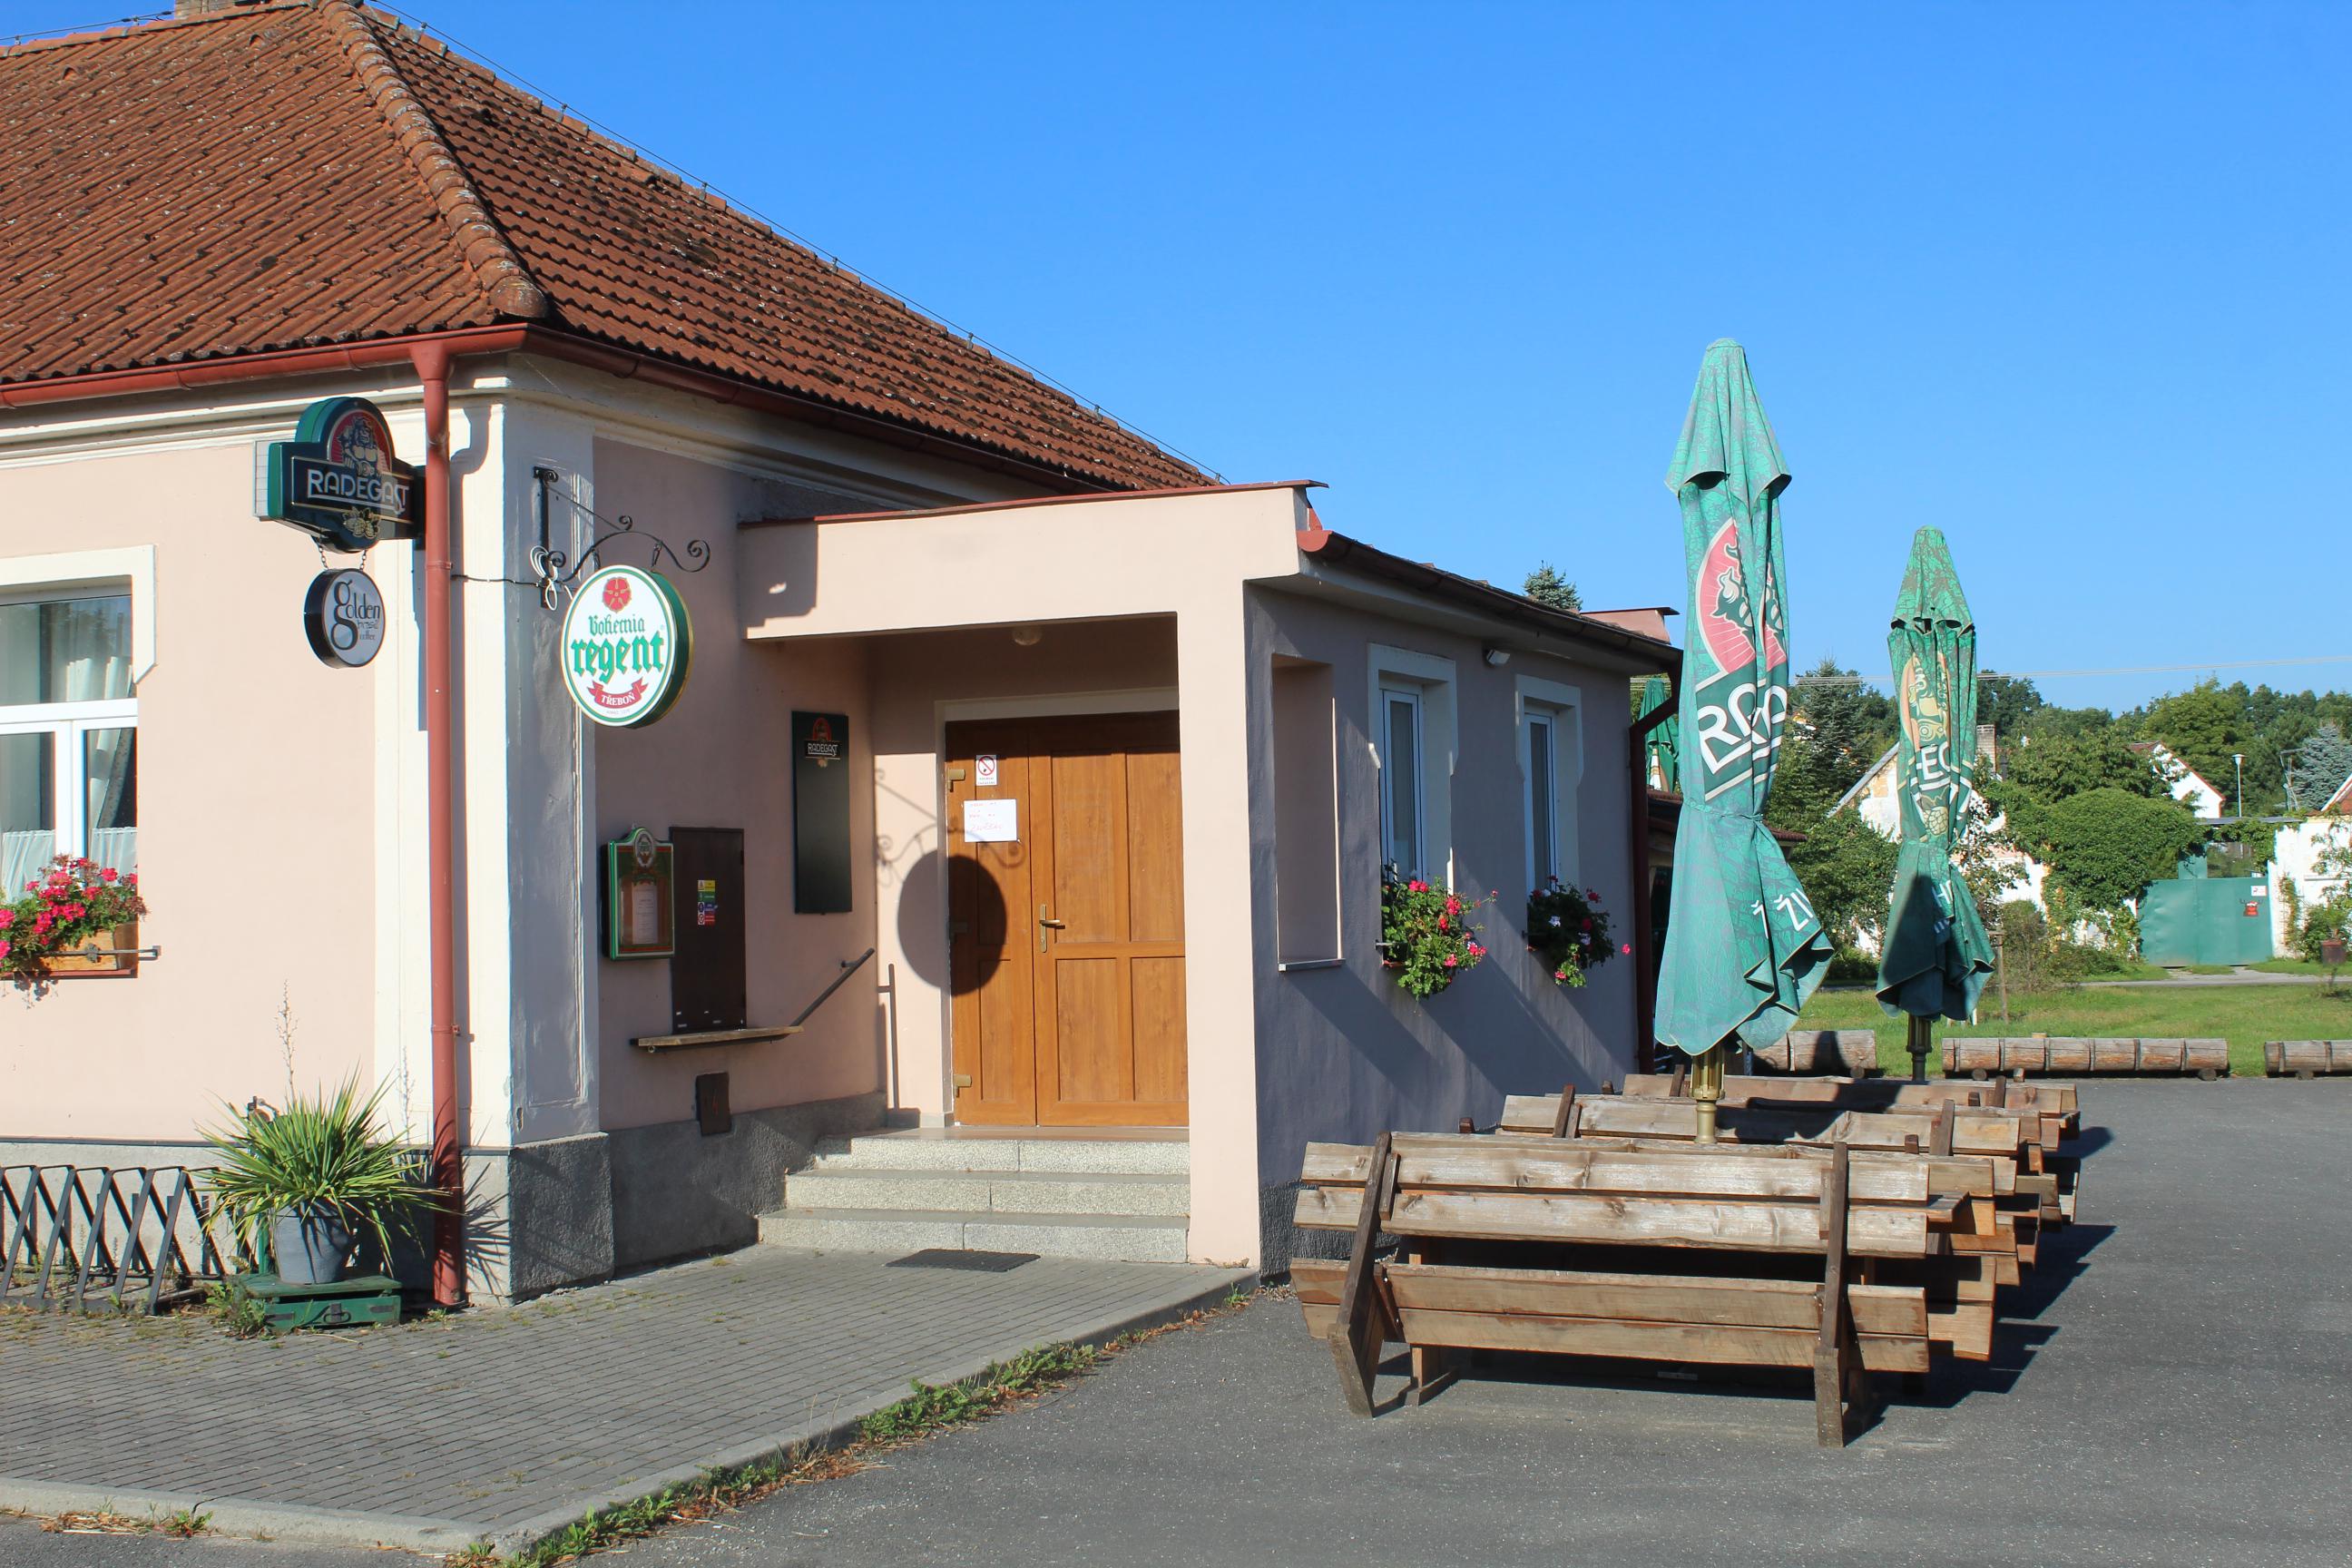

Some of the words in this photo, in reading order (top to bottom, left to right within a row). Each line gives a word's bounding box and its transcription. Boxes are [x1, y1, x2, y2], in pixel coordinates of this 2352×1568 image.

[307, 468, 410, 515] RADEGAST
[331, 580, 380, 650] golden
[588, 613, 645, 635] Bohemia
[571, 631, 664, 685] regent
[601, 691, 636, 706] TŘEBOŇ
[808, 742, 838, 757] RADEGAST
